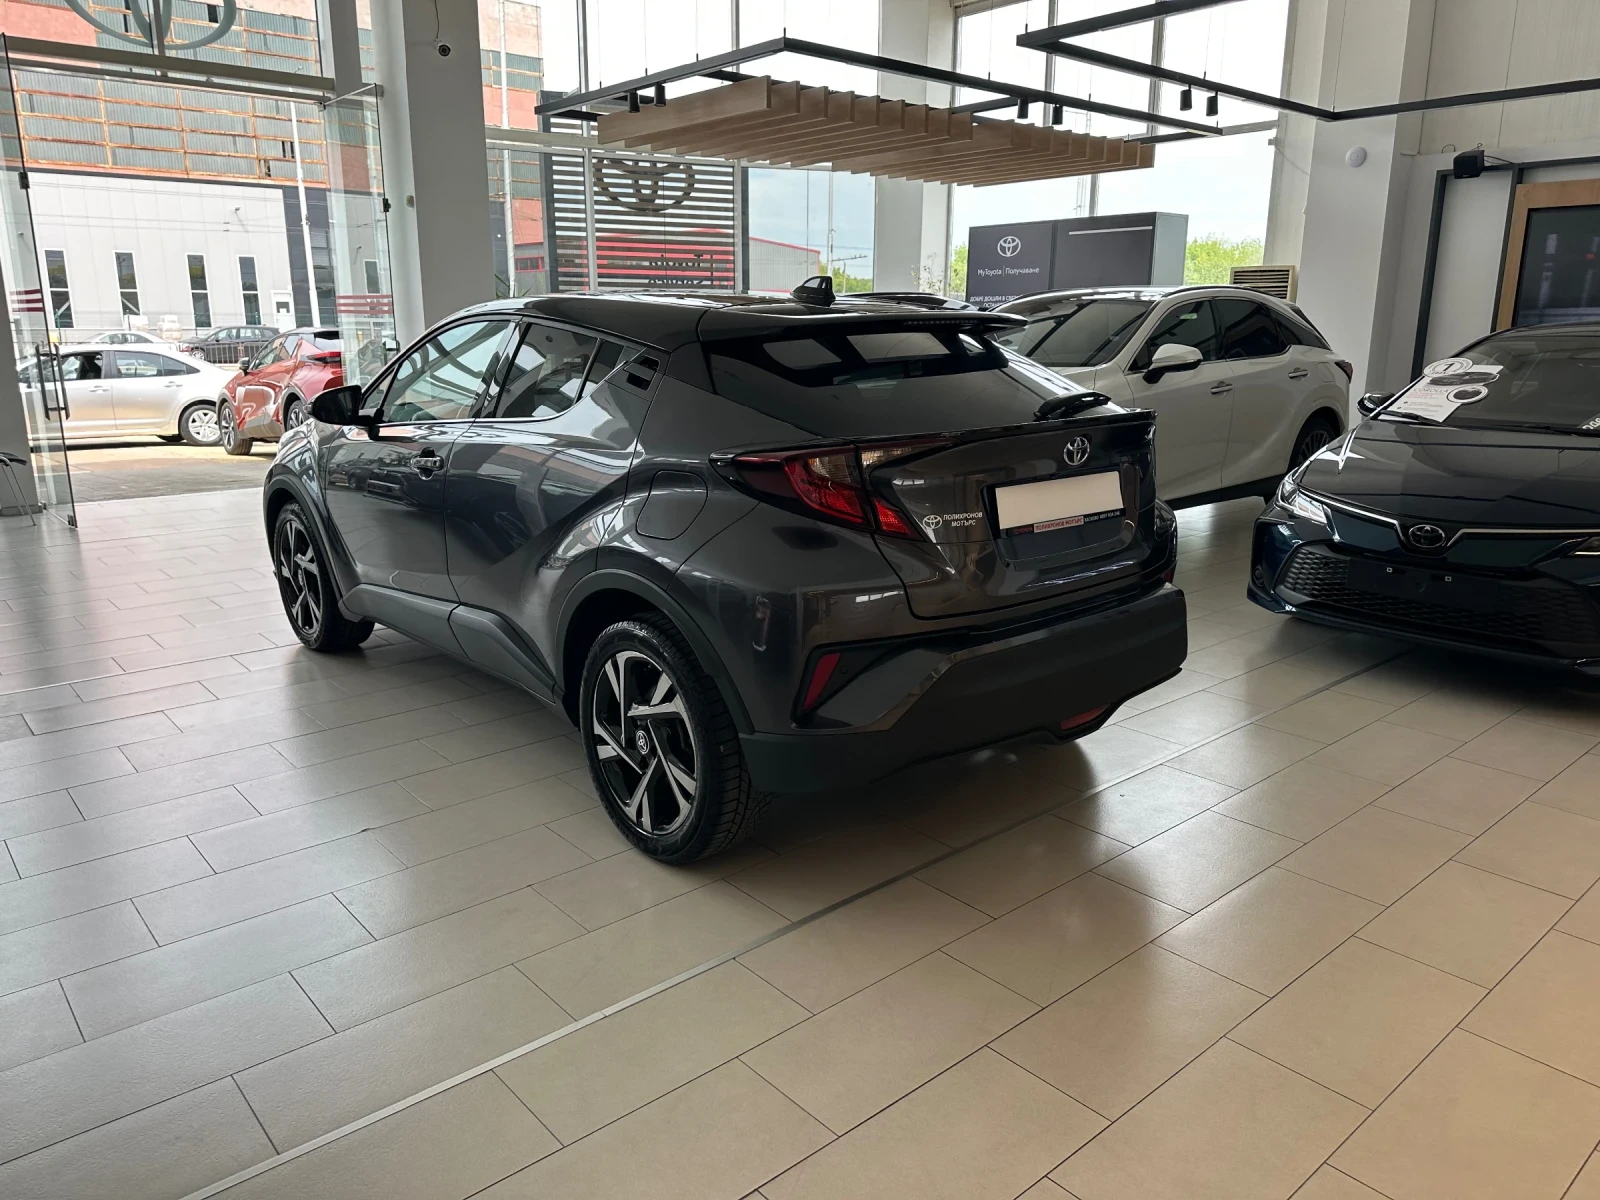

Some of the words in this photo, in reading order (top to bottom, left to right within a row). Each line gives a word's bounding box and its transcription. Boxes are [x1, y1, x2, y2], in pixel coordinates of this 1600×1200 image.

[1005, 267, 1040, 275] Получаване
[943, 512, 983, 520] ПОЛИХРОНОВ
[1035, 521, 1066, 532] ПОЛИХРОНОВ
[1065, 518, 1083, 527] МОТЪРС
